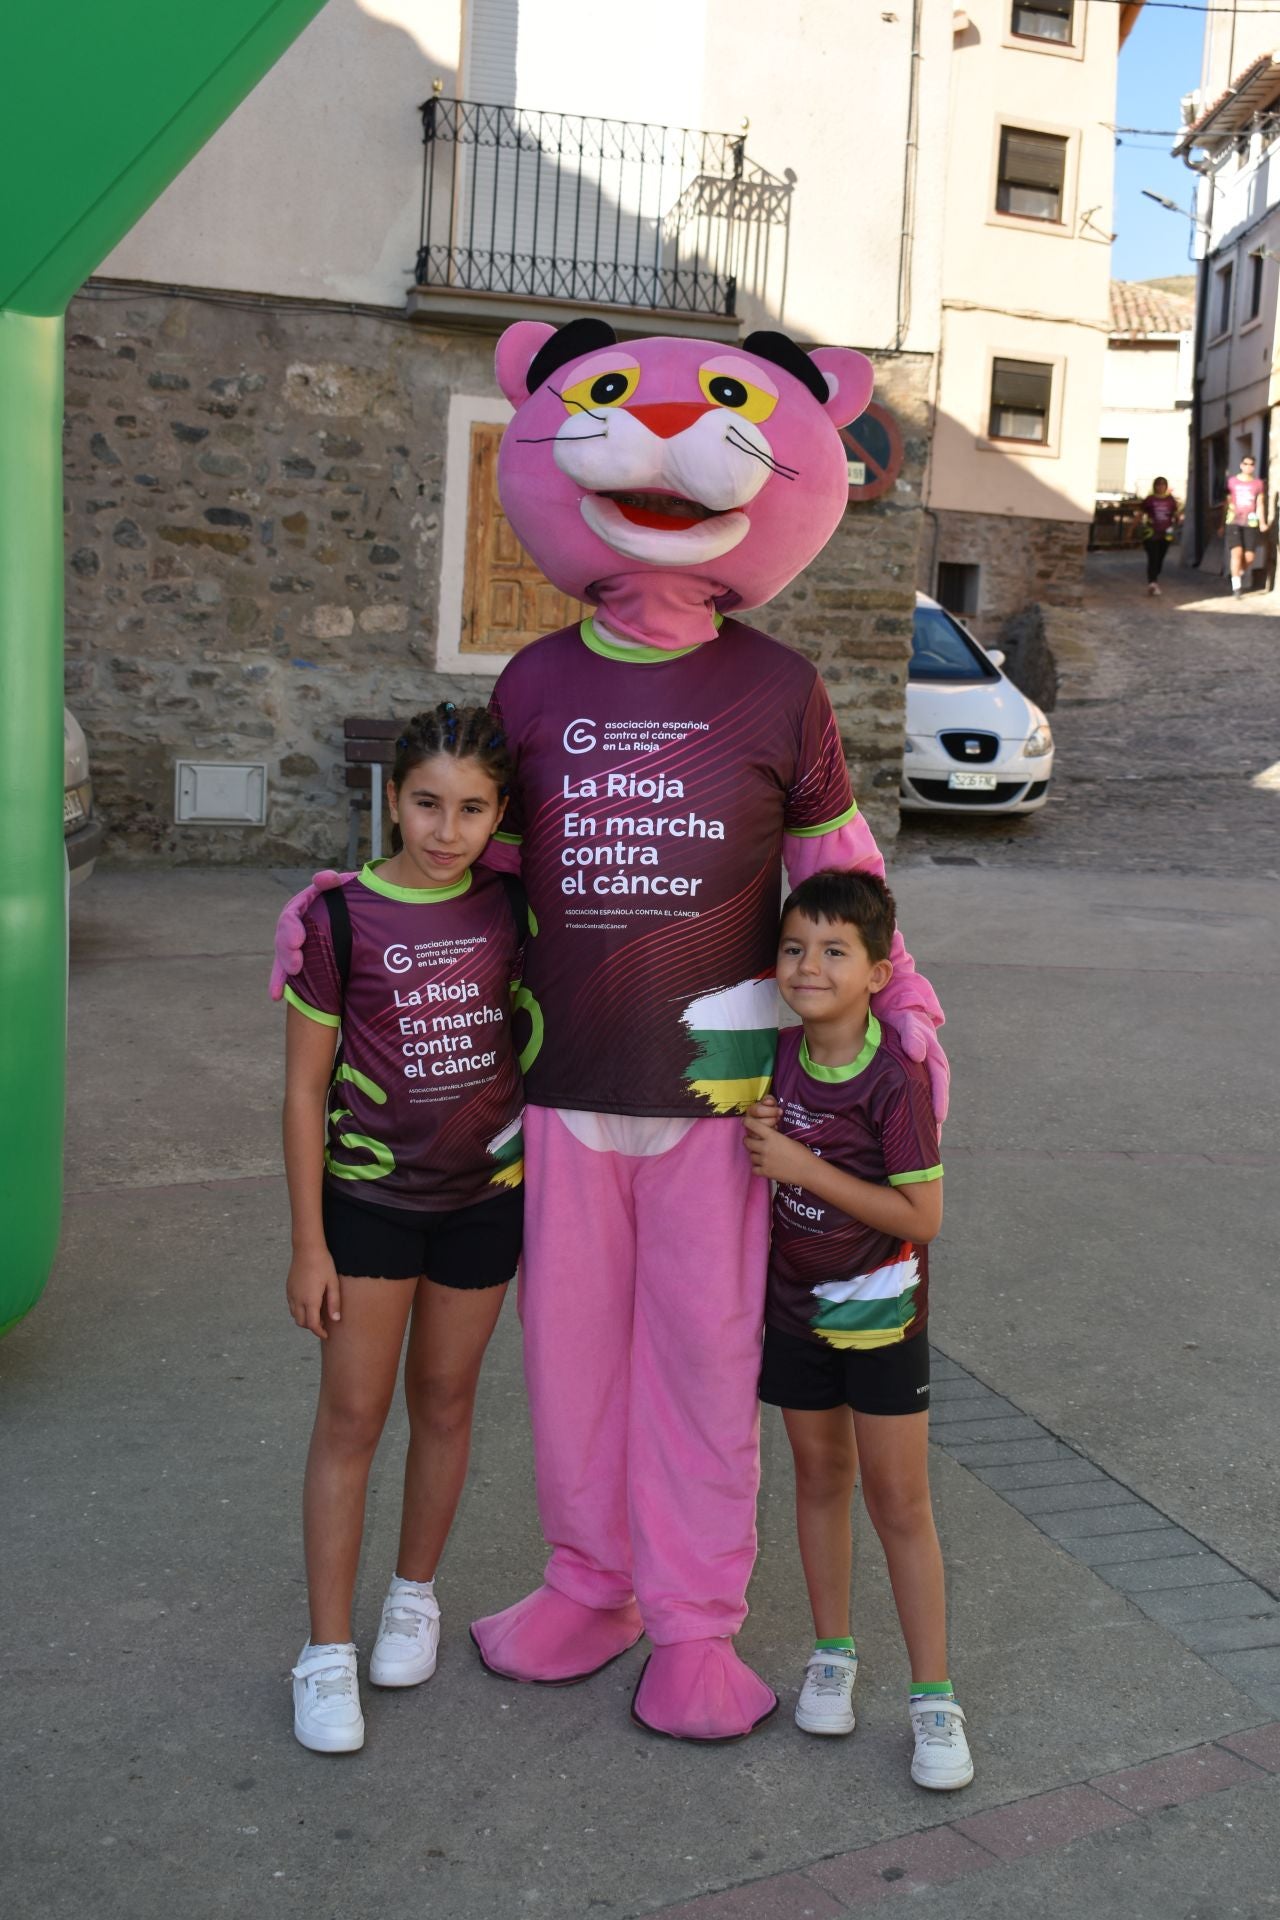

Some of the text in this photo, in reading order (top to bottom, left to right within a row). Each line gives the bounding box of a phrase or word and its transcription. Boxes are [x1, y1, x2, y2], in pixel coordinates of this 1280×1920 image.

[604, 720, 709, 731] asociación española
[604, 731, 687, 740] contra el cáncer
[602, 742, 660, 752] en La Rioja
[563, 773, 684, 803] La Rioja
[564, 812, 725, 840] En marcha
[561, 841, 658, 866] contra
[561, 869, 702, 896] el cáncer
[564, 908, 599, 916] ASOCIACIÓN
[600, 908, 634, 916] ESPAÑOLA
[673, 910, 700, 918] CÁNCER
[414, 936, 487, 951] asociación española
[416, 946, 475, 959] contra el cáncer
[438, 957, 458, 966] Rioja
[394, 979, 480, 1008] La Rioja
[399, 1005, 503, 1036] En marcha
[402, 1034, 473, 1057] contra
[404, 1050, 497, 1079] el cáncer
